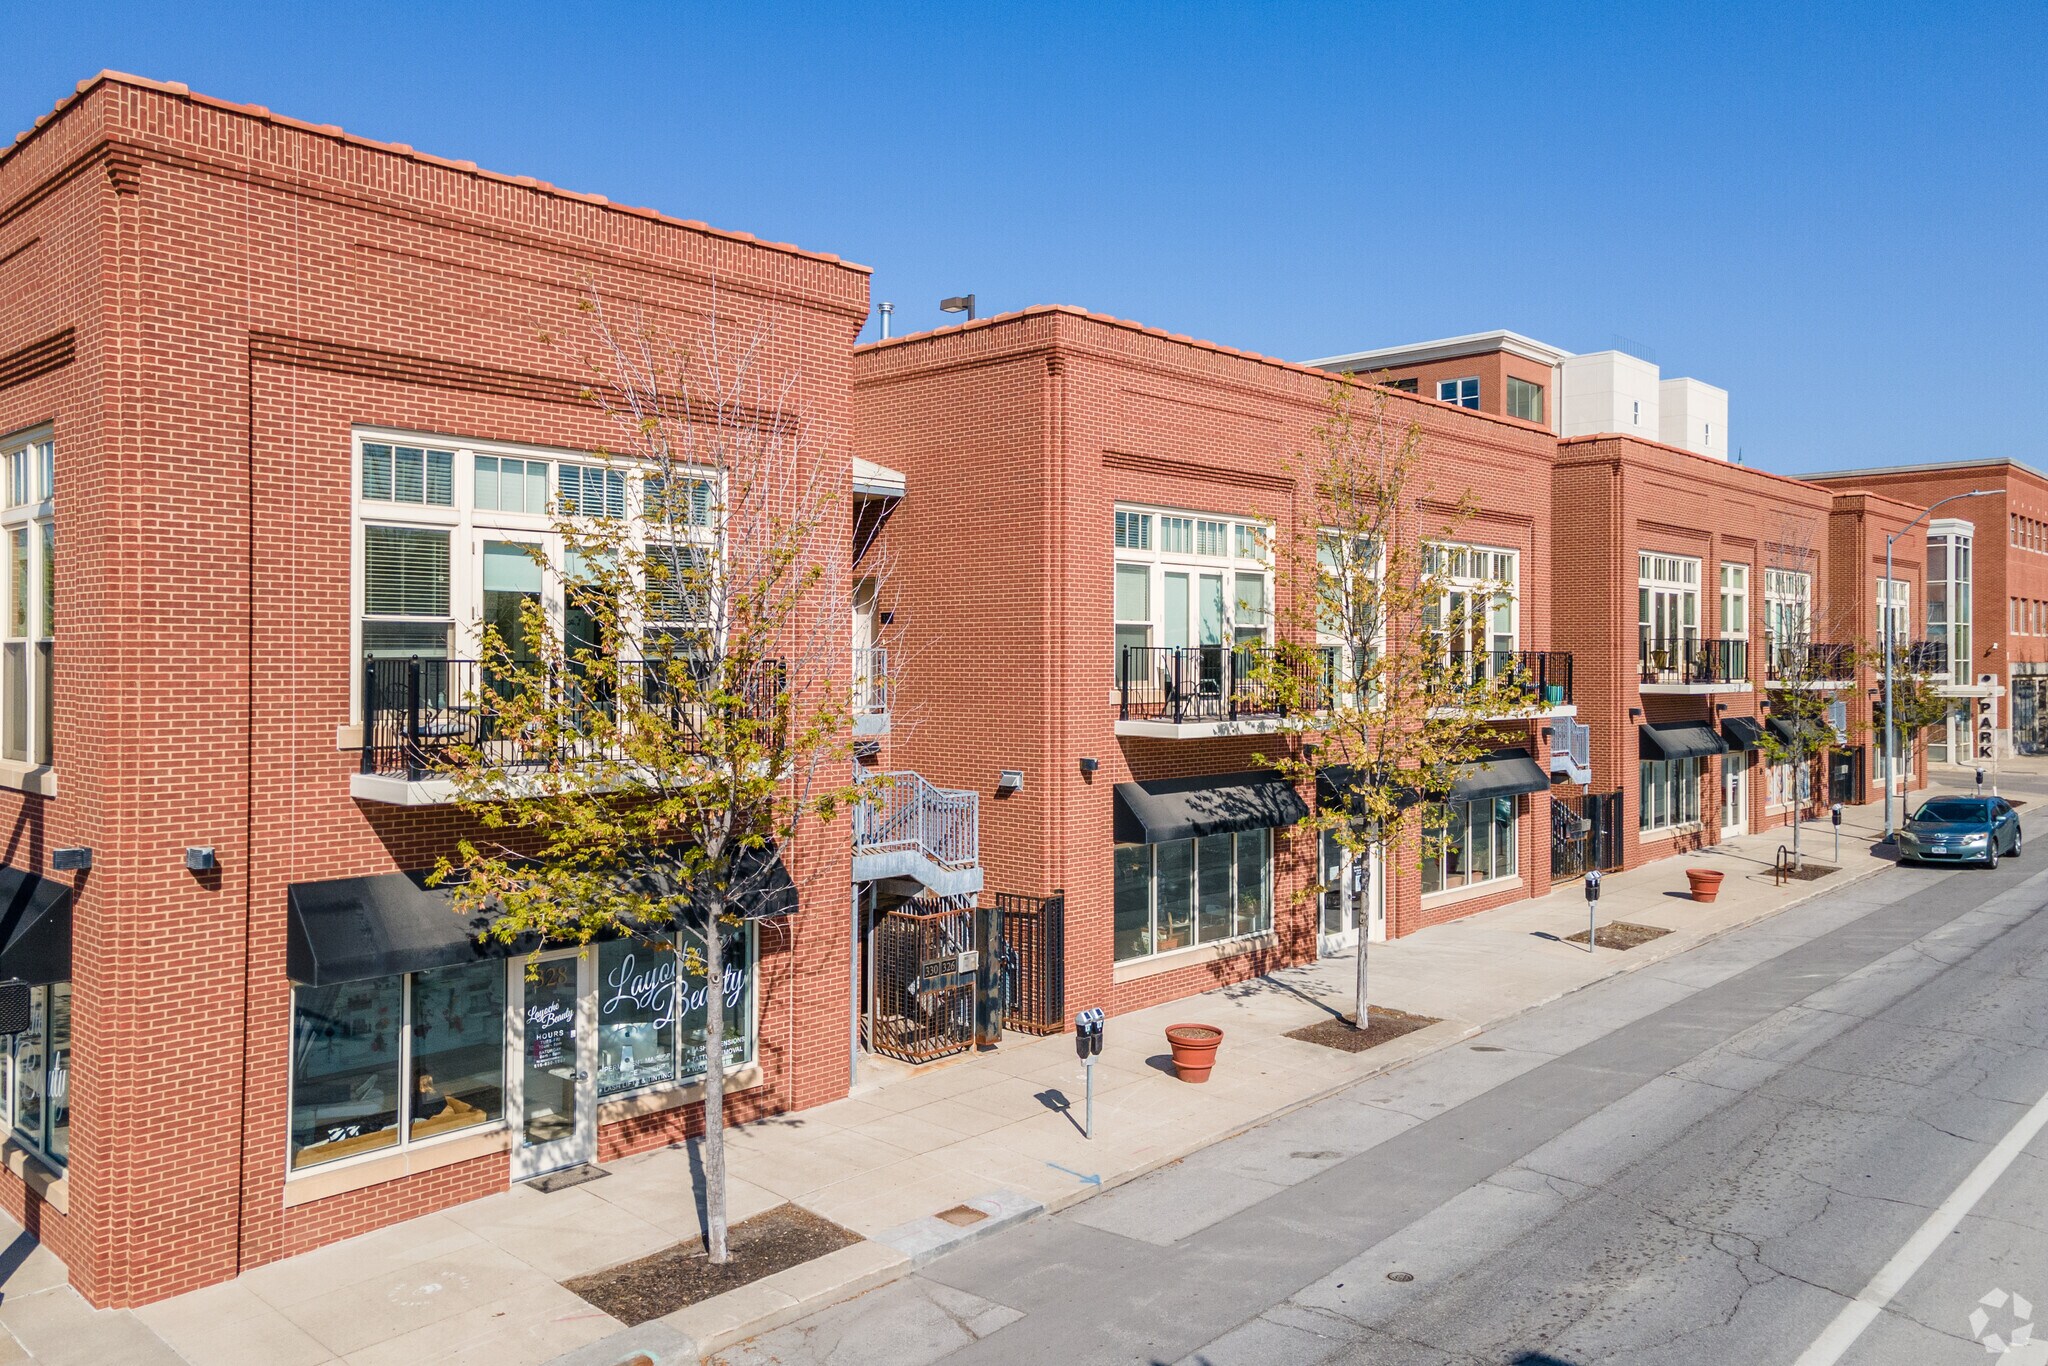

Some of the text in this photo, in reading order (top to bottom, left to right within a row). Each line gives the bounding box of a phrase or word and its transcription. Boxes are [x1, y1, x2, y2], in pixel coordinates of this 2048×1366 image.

[1980, 702, 1992, 758] PARK
[532, 966, 568, 989] 328
[925, 961, 956, 976] 330 326
[652, 963, 745, 1030] Beaty
[541, 1007, 574, 1029] Beauty
[536, 1030, 564, 1041] HOURS
[723, 1046, 743, 1055] MOVAL
[603, 1083, 621, 1093] LASH
